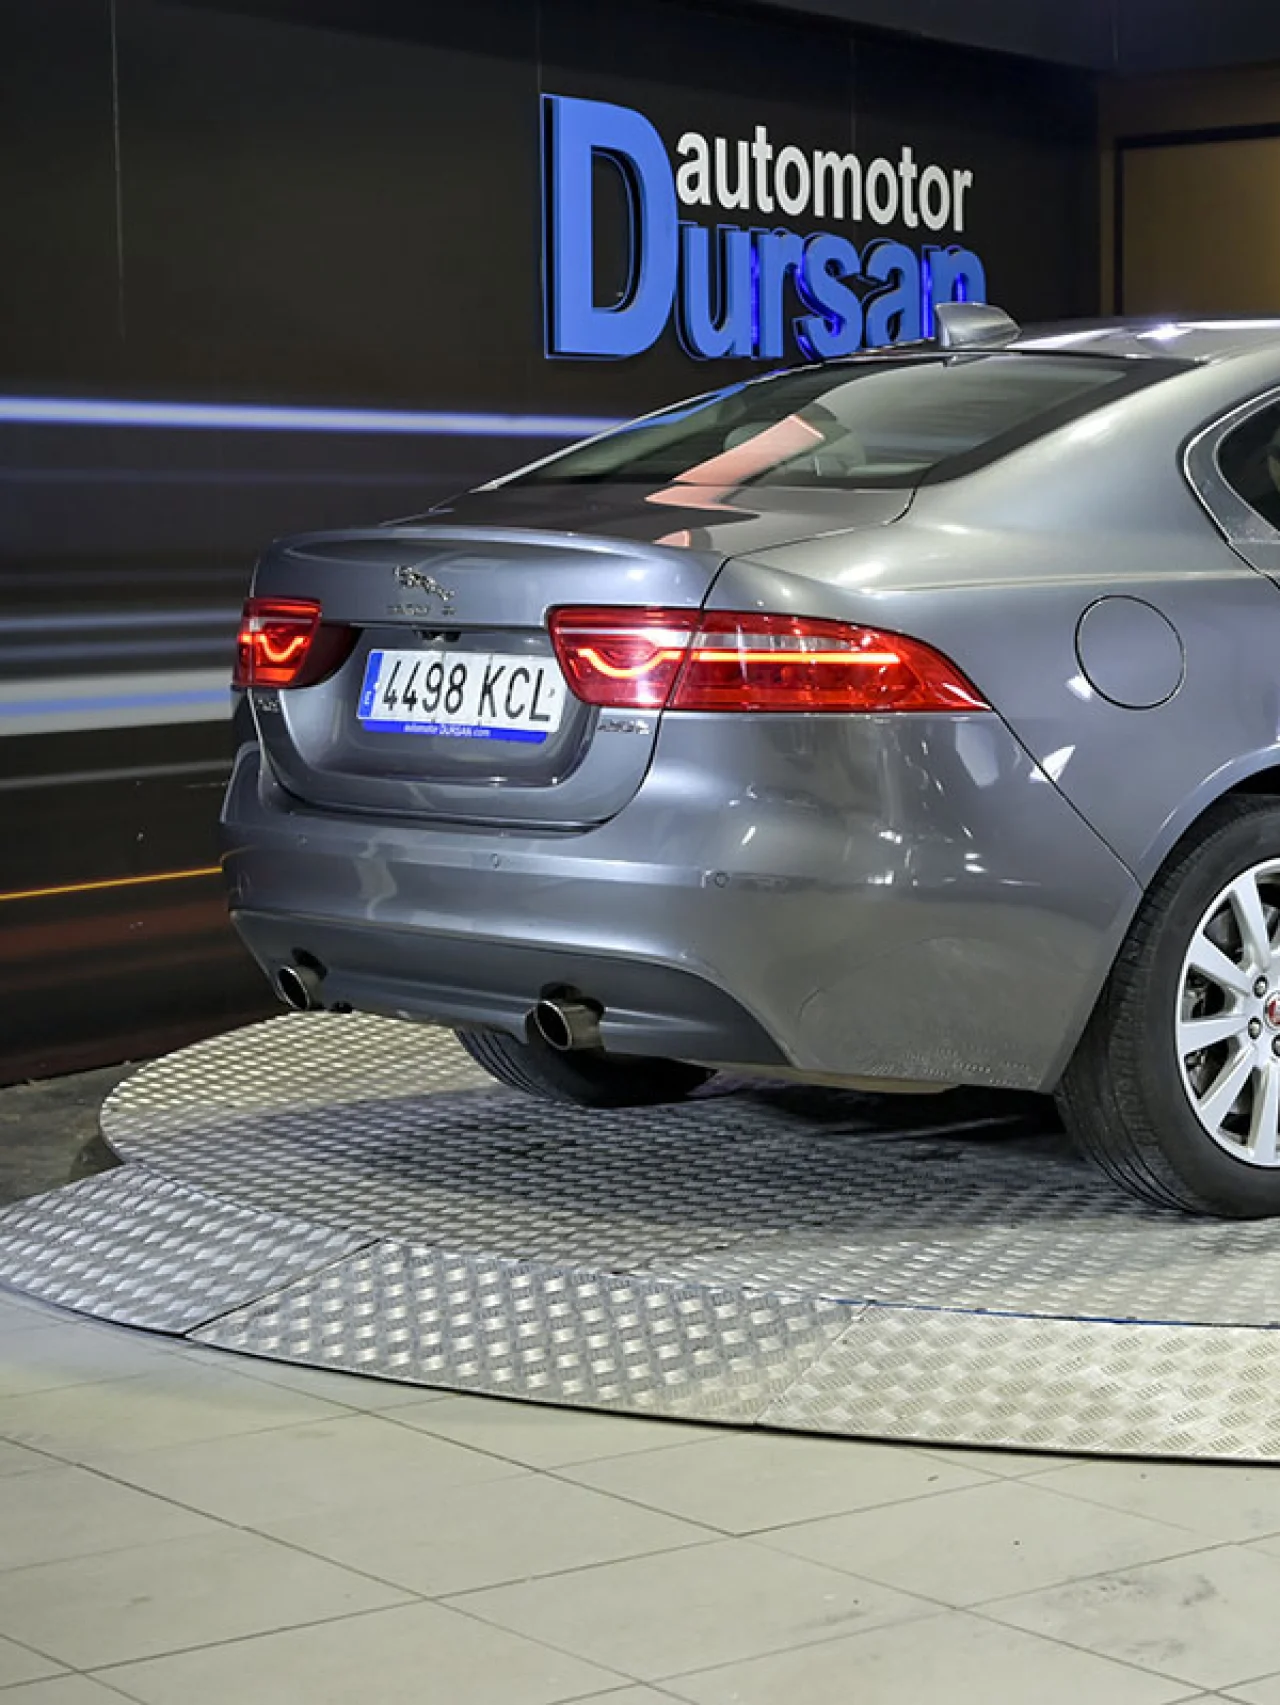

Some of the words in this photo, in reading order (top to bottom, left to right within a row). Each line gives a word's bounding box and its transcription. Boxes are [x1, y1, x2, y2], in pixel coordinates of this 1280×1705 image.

[676, 125, 972, 232] automotor
[383, 660, 467, 715] 4498
[478, 664, 550, 721] KCL
